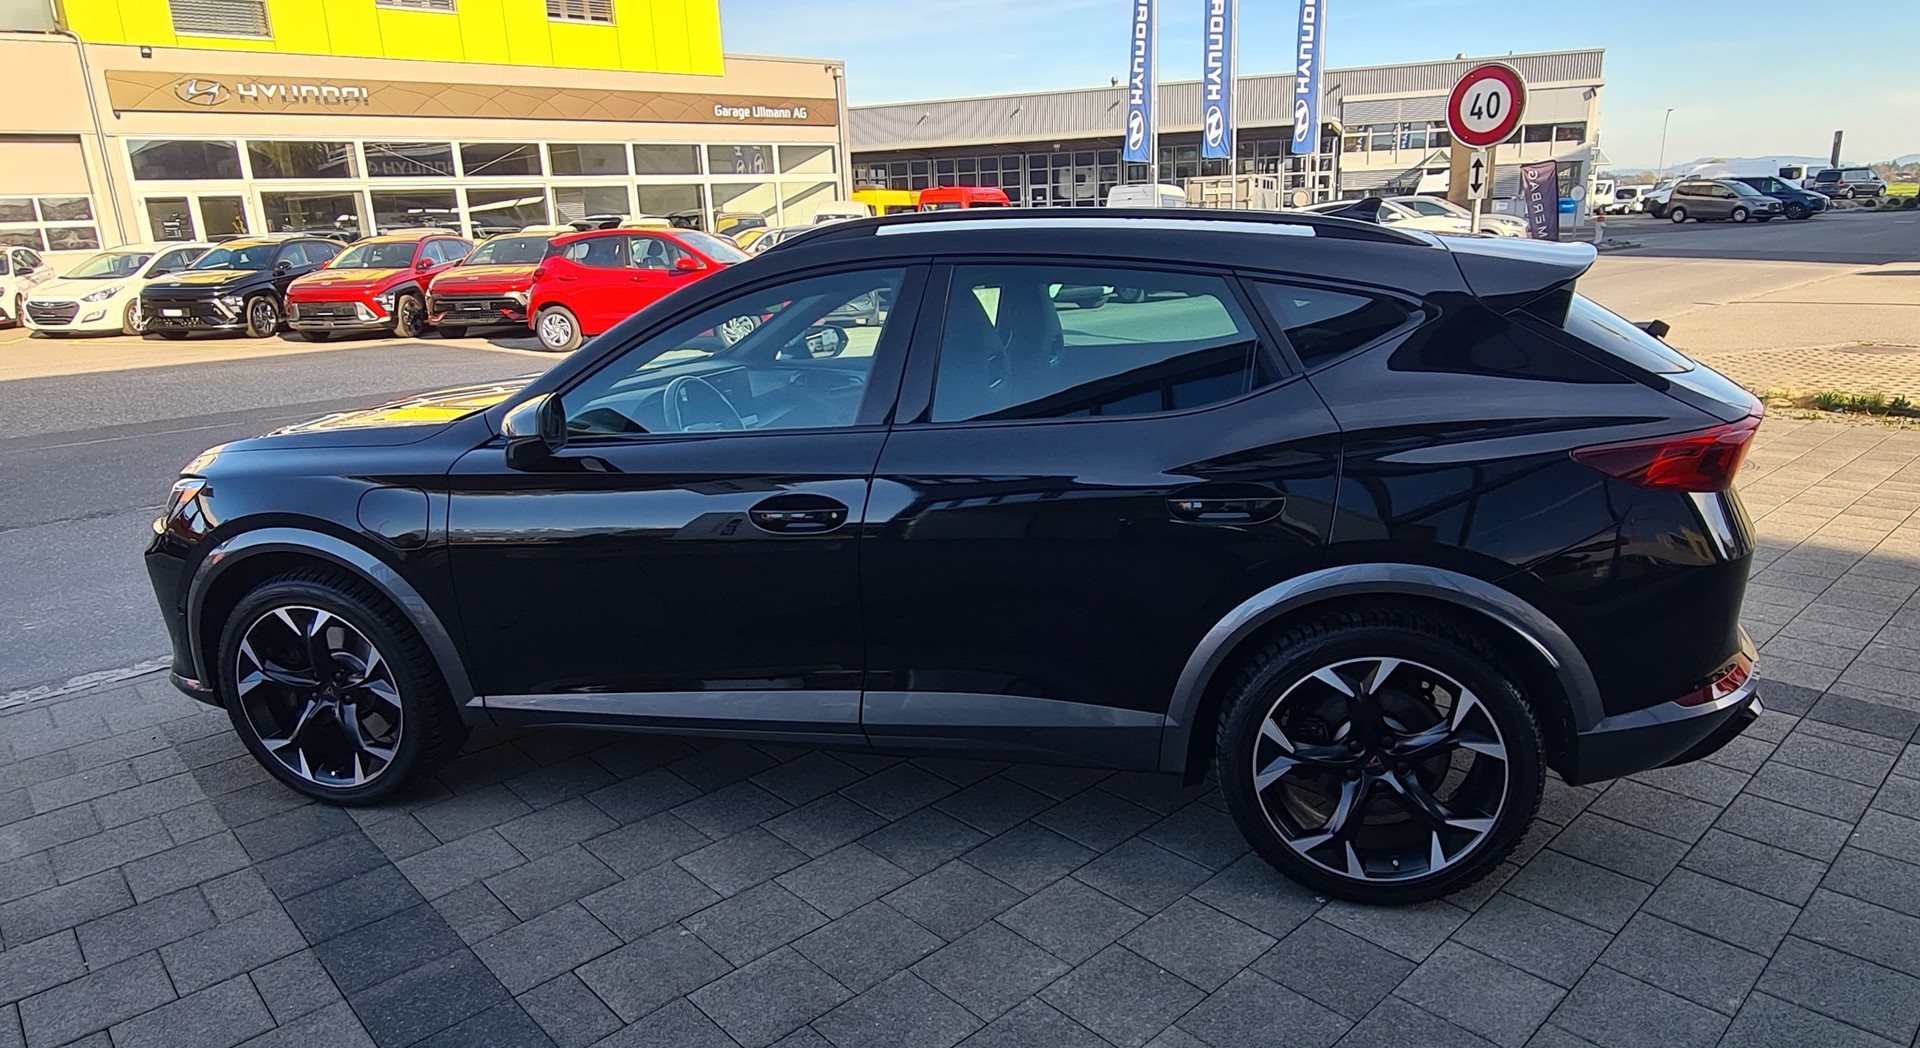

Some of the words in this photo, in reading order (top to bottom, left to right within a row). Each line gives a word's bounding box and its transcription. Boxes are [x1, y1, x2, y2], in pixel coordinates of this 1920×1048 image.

[237, 82, 369, 106] HYUNDAI
[1470, 91, 1501, 120] 40
[714, 104, 751, 120] Garage
[752, 106, 791, 119] Ullmann
[793, 107, 808, 119] AG
